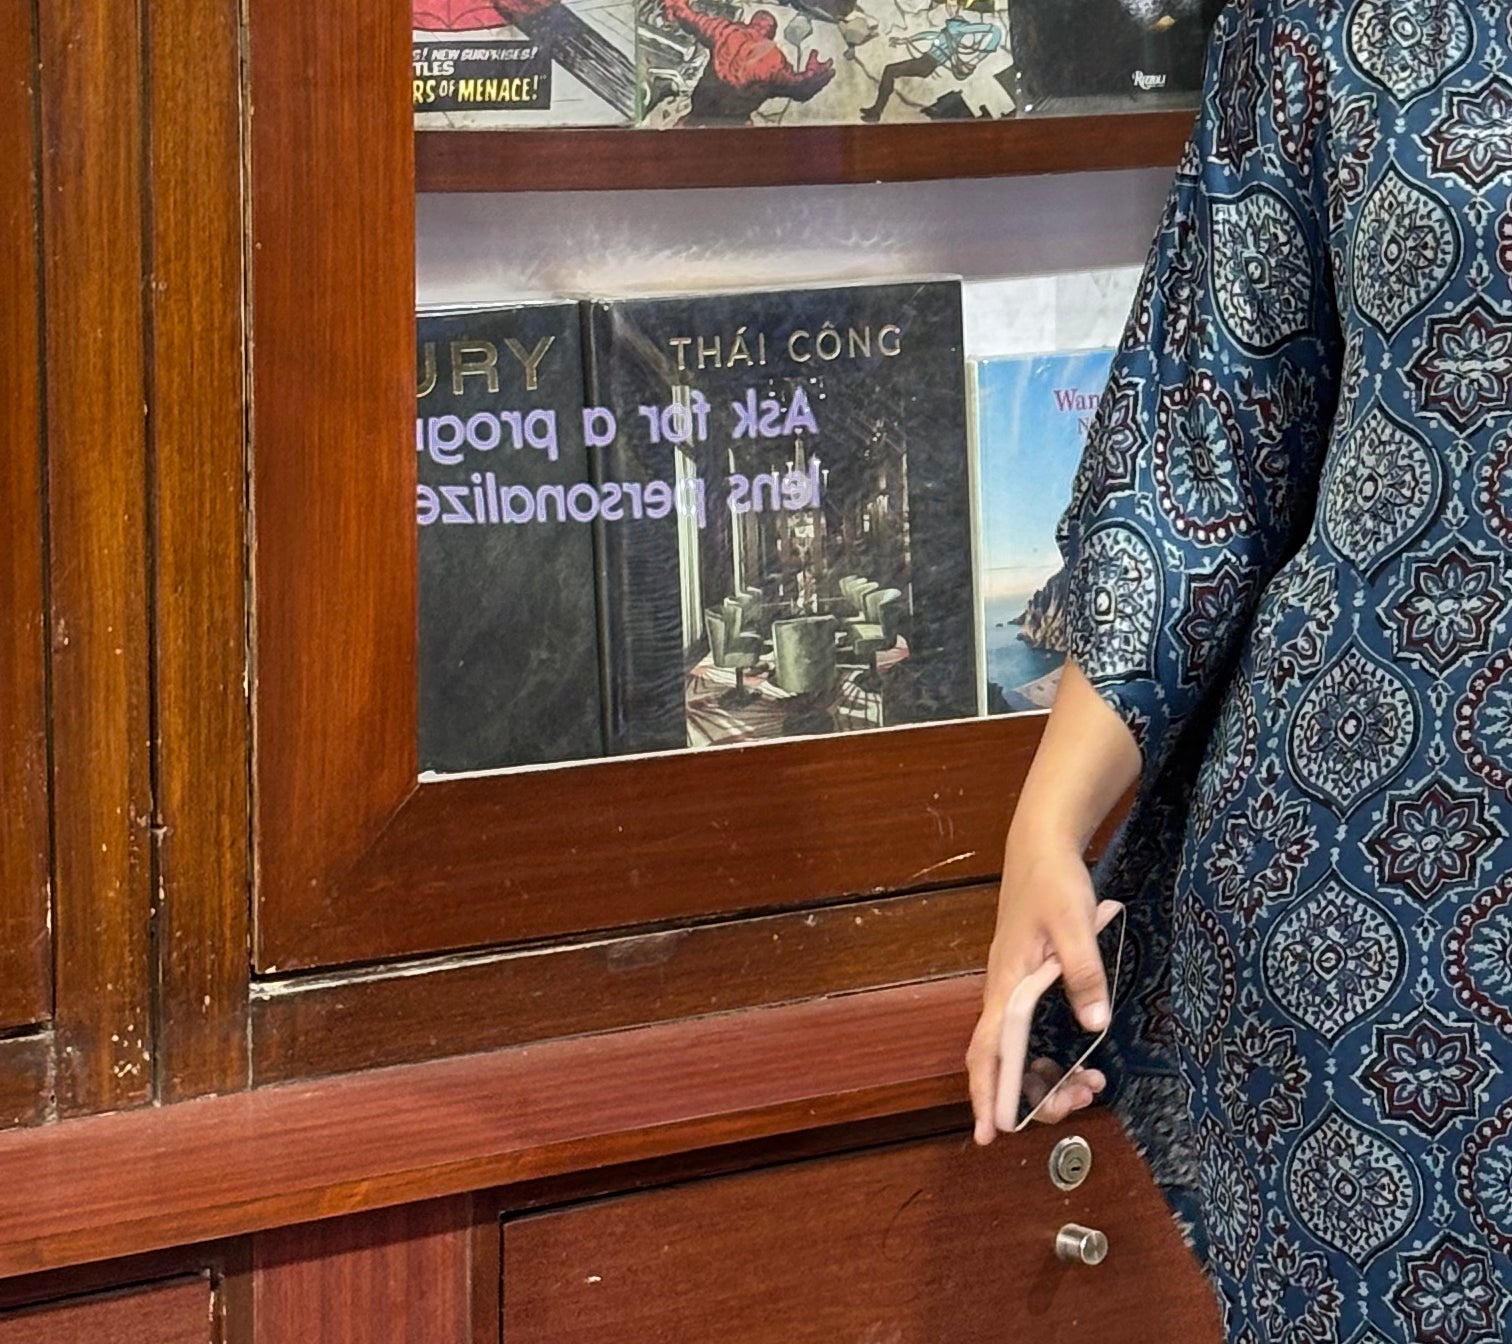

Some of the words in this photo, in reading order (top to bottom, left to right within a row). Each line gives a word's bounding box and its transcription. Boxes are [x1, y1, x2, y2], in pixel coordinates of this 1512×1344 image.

[439, 79, 456, 98] OF
[669, 325, 769, 371] THÁI
[787, 320, 902, 363] CÔNG
